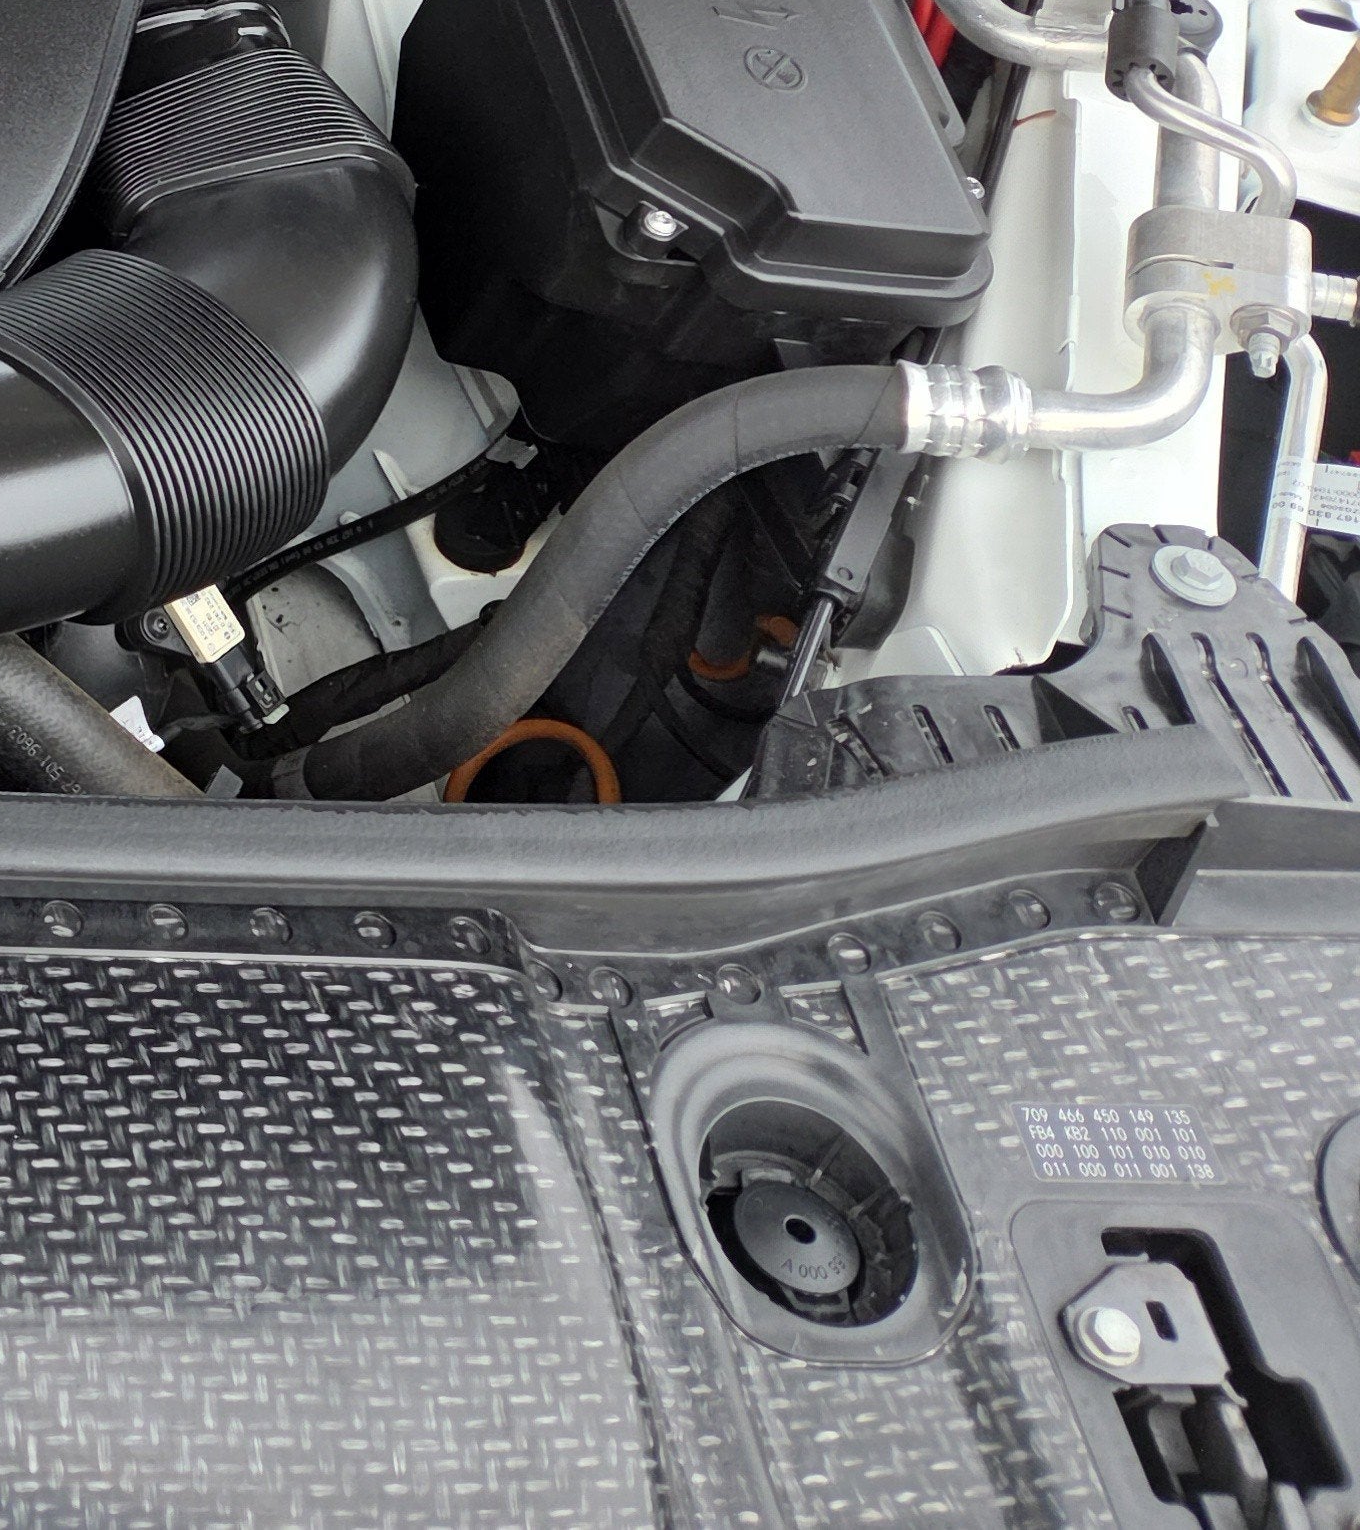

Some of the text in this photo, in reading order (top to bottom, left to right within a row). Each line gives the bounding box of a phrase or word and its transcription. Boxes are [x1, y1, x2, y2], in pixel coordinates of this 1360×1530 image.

[1021, 1108, 1191, 1125] 709 466 450 149 135
[1029, 1125, 1198, 1143] FB4 KB2 110 001 101
[1036, 1144, 1206, 1161] 000 100 101 010 010
[1043, 1162, 1214, 1179] 011 000 011 001 138
[799, 1263, 828, 1280] 000
